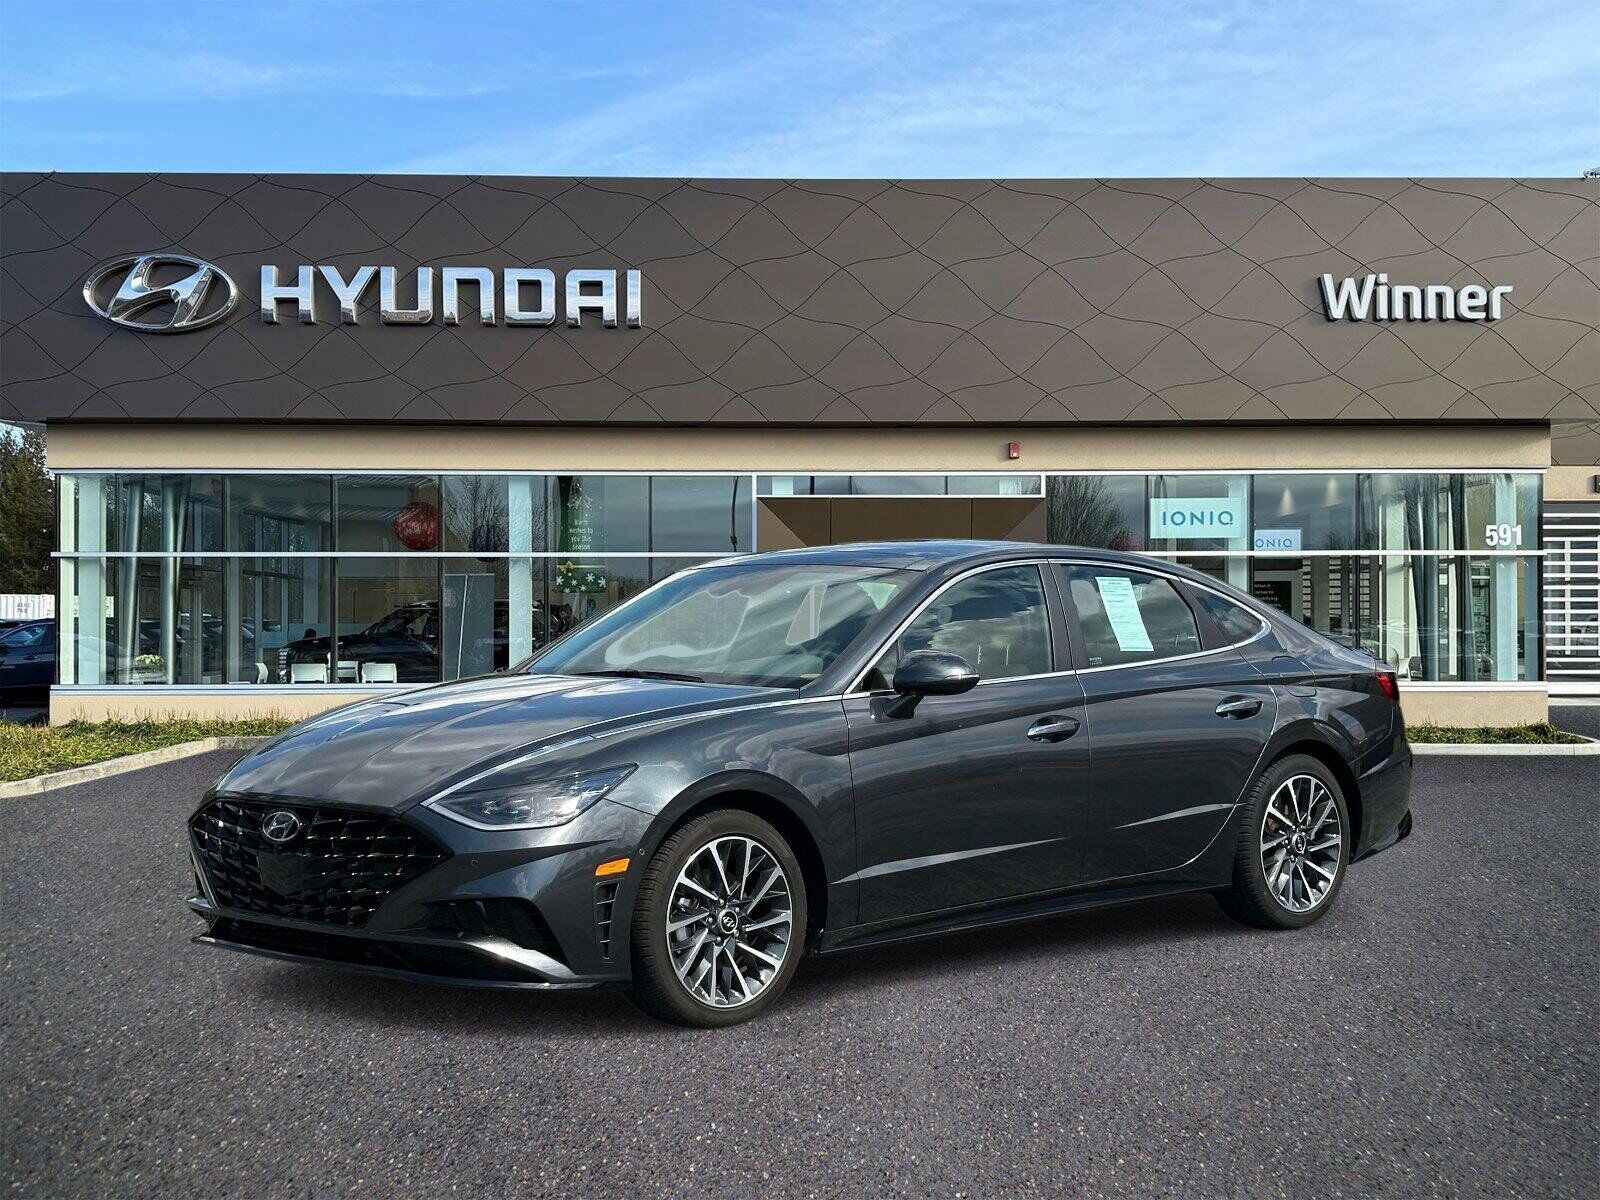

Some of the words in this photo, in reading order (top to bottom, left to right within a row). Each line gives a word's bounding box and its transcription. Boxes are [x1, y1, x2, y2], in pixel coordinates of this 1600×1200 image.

[260, 264, 642, 328] HYUNDAI
[1319, 273, 1514, 322] Winner
[1161, 510, 1234, 526] IONIQ
[1255, 538, 1293, 548] ONIQ
[1485, 523, 1523, 547] 591
